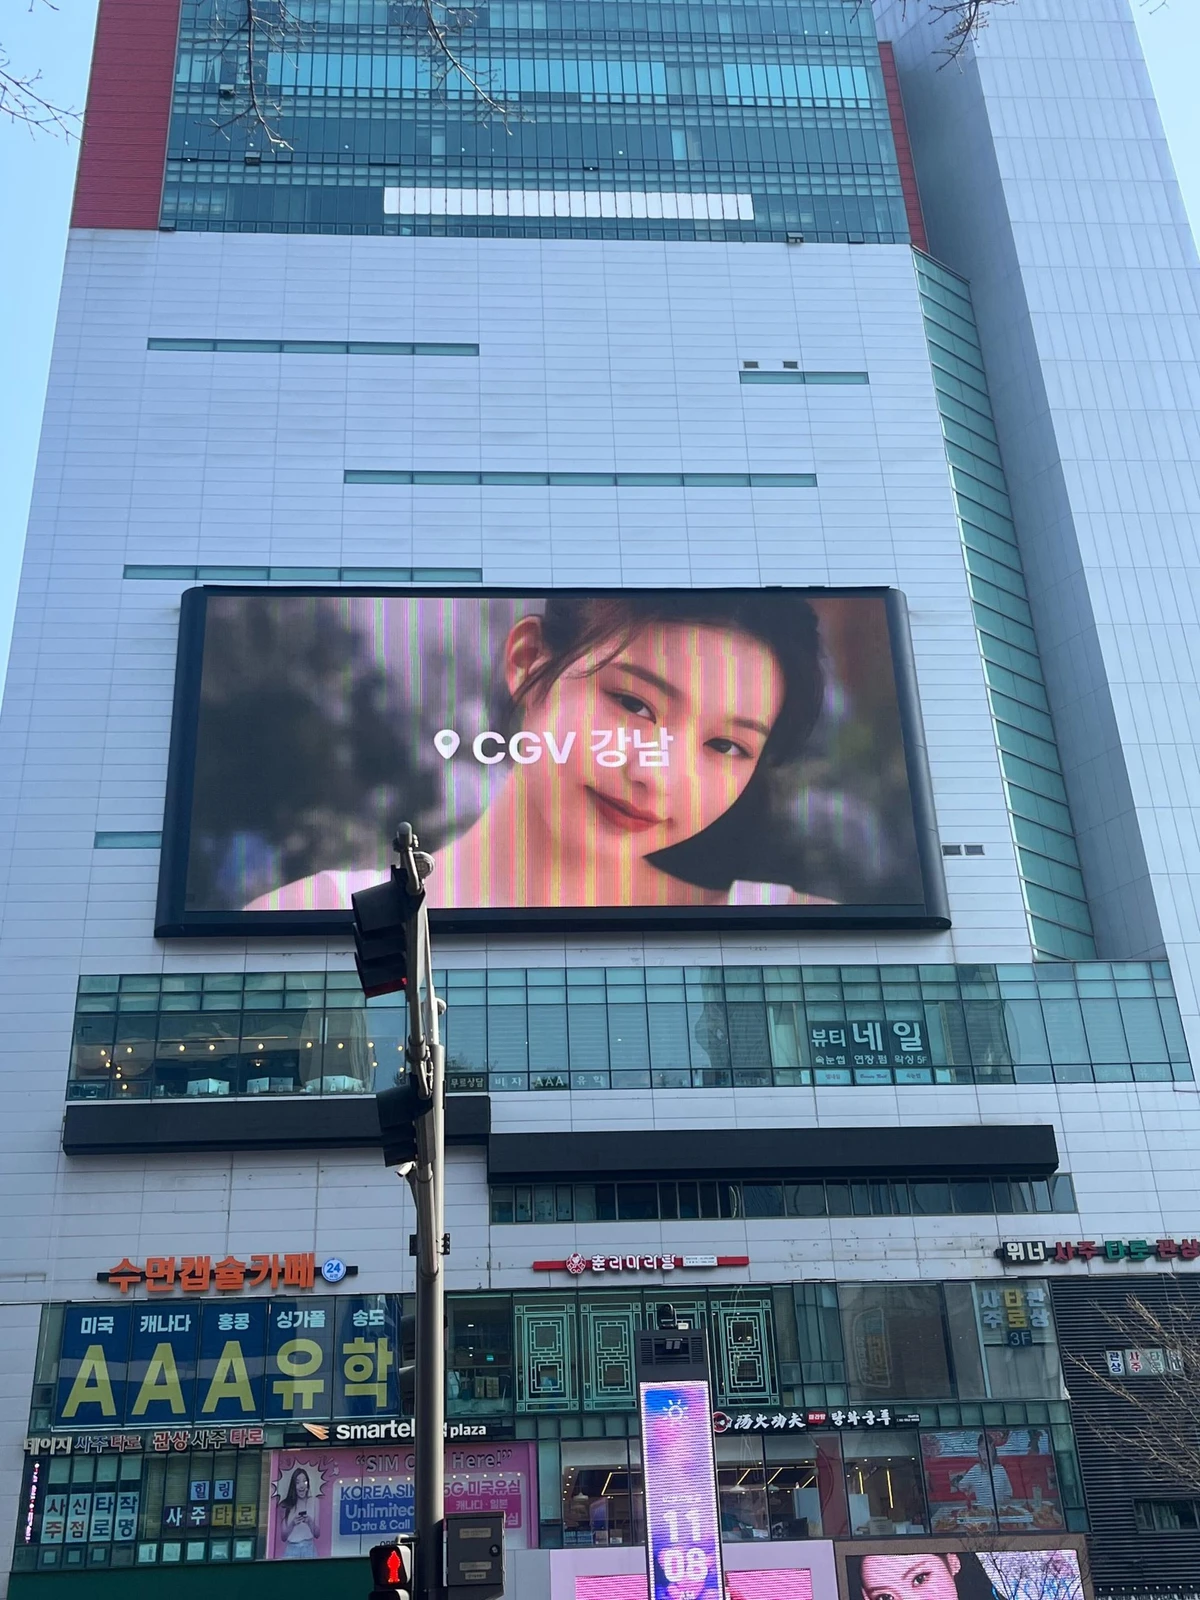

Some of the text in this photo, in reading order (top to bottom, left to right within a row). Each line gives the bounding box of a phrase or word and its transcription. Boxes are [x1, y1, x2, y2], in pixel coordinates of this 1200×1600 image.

[472, 727, 674, 768] CGV 강남
[811, 1022, 924, 1052] 뷰티 네일
[815, 1055, 846, 1065] 속눈썹
[917, 1055, 928, 1065] 5F
[450, 1077, 484, 1089] 무료상담
[495, 1075, 604, 1088] 비자 AAA 유학
[1006, 1239, 1200, 1261] 위너 사주 타로 관상
[326, 1261, 342, 1274] 24
[591, 1254, 676, 1271] 춘리마라탕
[108, 1252, 316, 1293] 수면캡슐카페
[981, 1289, 1003, 1328] 사주
[1004, 1289, 1028, 1328] 타로
[81, 1309, 385, 1335] 미국 캐나다 홍콩 싱가폴 송도
[1010, 1331, 1032, 1346] 3F
[336, 1418, 416, 1440] smartel
[450, 1423, 487, 1438] plaza
[74, 1435, 109, 1454] 사주
[110, 1434, 142, 1453] 타로
[153, 1431, 191, 1452] 관상
[191, 1429, 228, 1450] 사주
[229, 1427, 265, 1449] 타로
[193, 1481, 232, 1499] 힐링
[340, 1484, 393, 1500] KOREA
[444, 1479, 521, 1497] 5G 미국유심
[455, 1498, 509, 1511] 캐나다 일본
[351, 1518, 411, 1532] Data & Call
[663, 1509, 701, 1543] 11
[664, 1547, 709, 1583] 08
